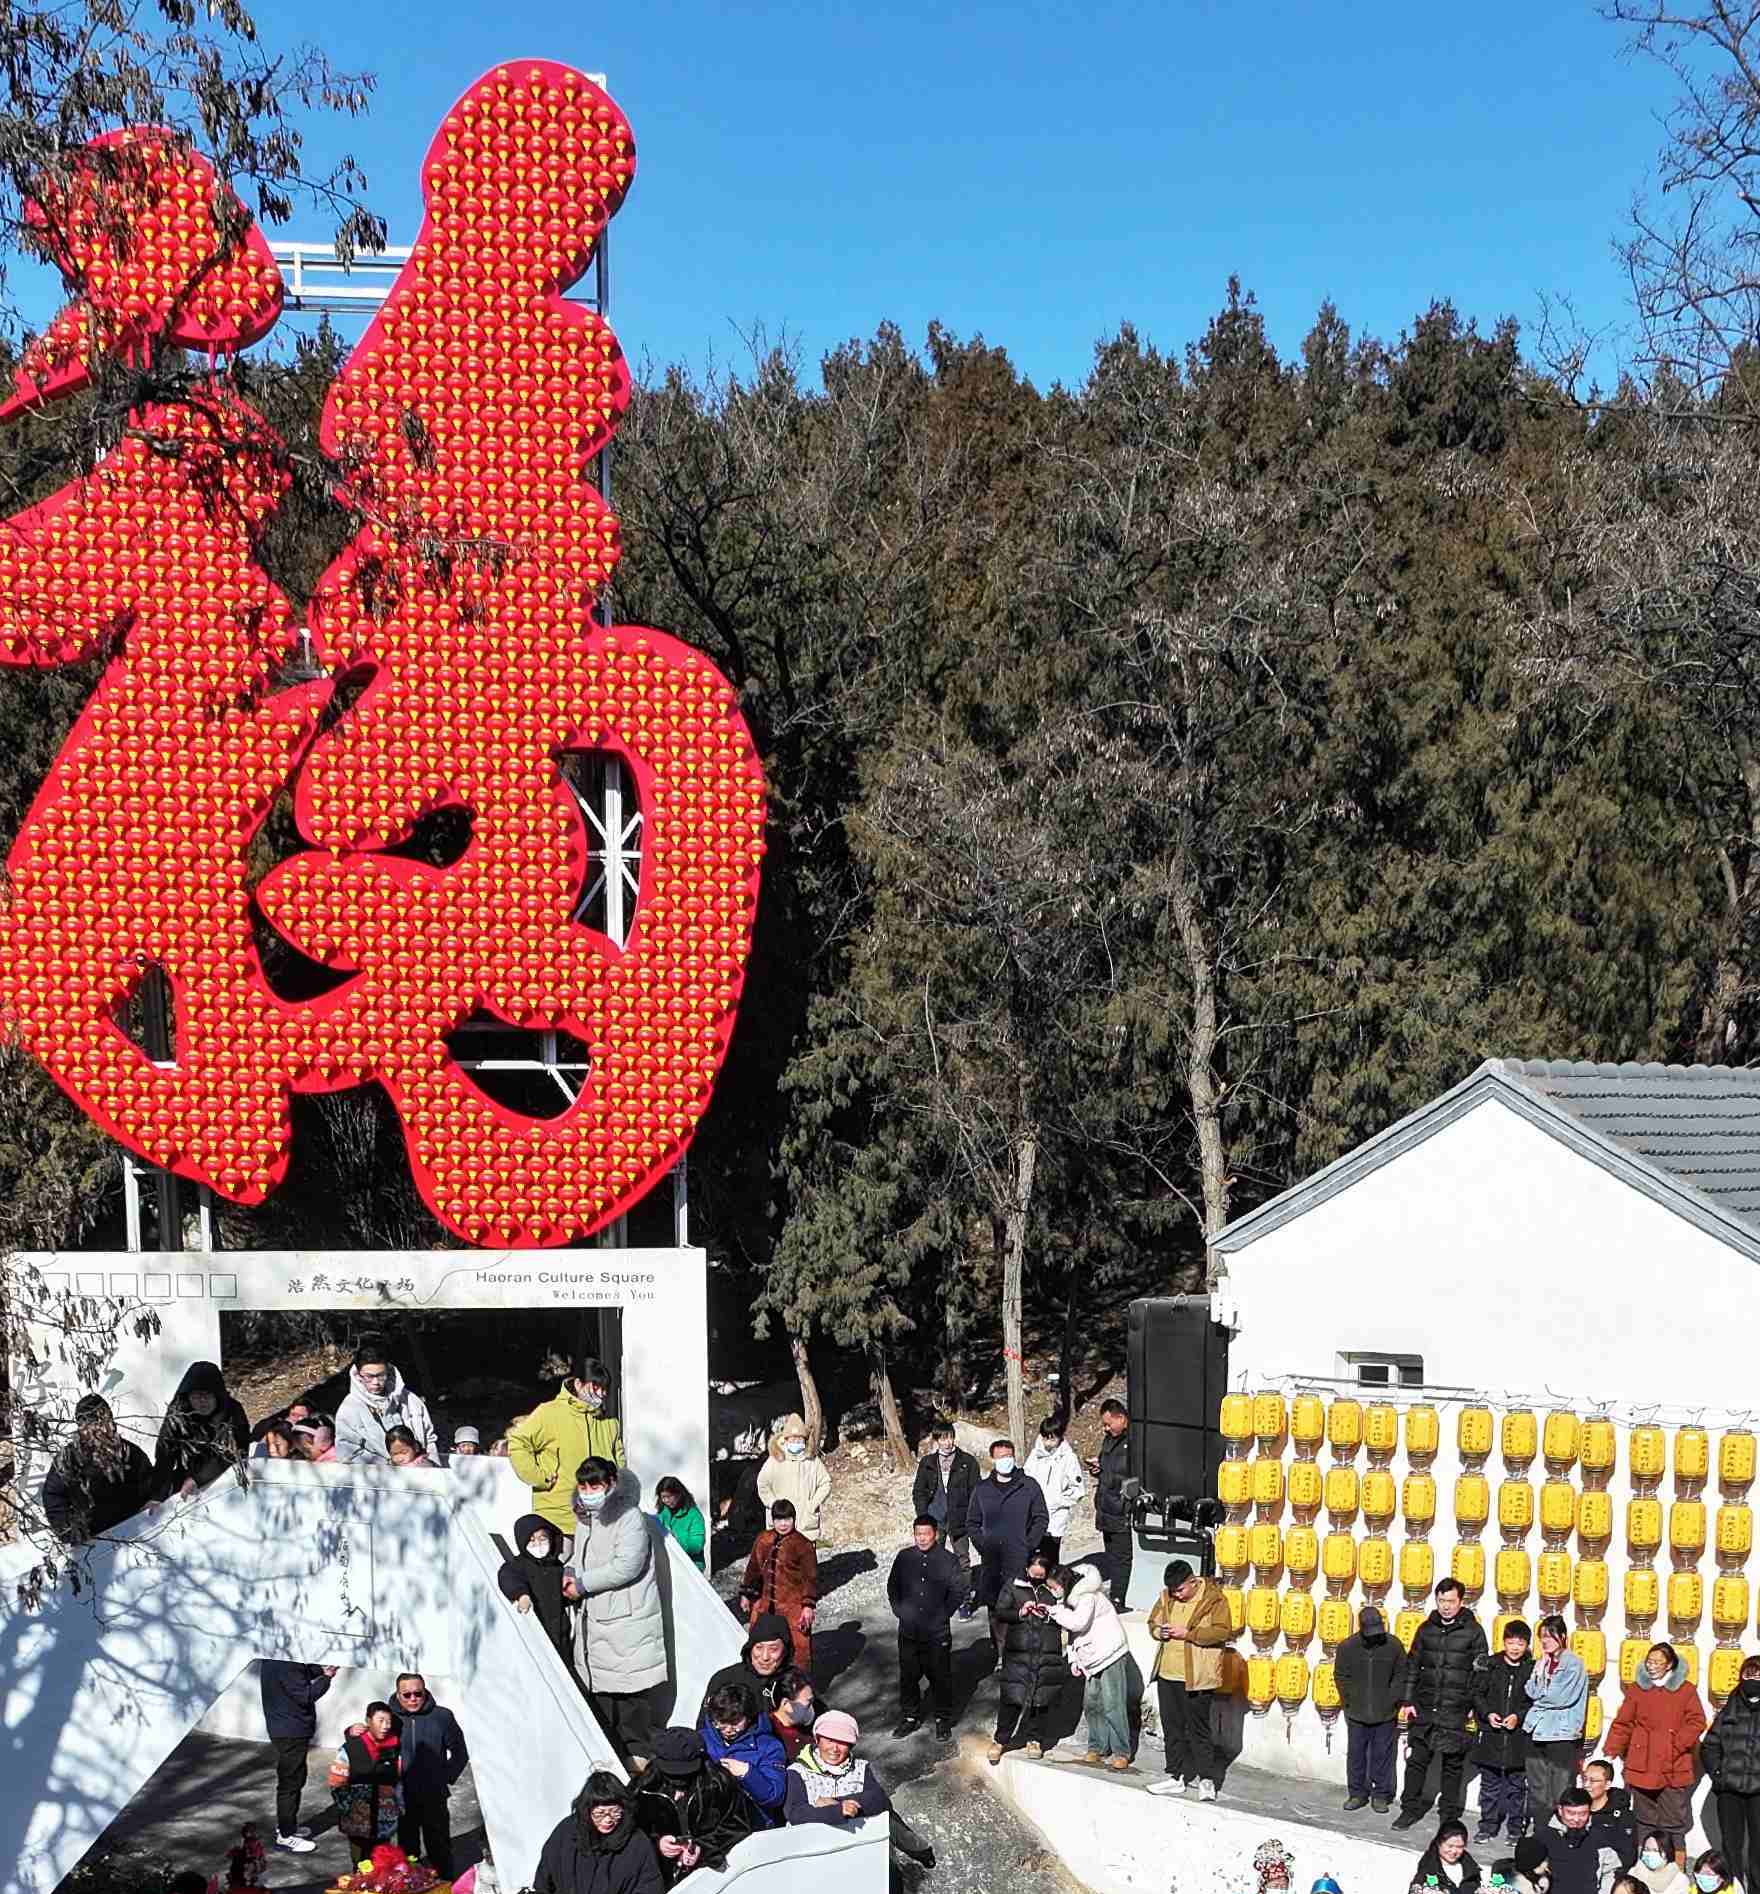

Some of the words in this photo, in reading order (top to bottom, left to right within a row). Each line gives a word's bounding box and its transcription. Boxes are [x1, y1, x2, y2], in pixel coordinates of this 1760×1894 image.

[476, 1272, 532, 1283] Haoran
[538, 1272, 594, 1283] Culture
[600, 1272, 655, 1285] Square
